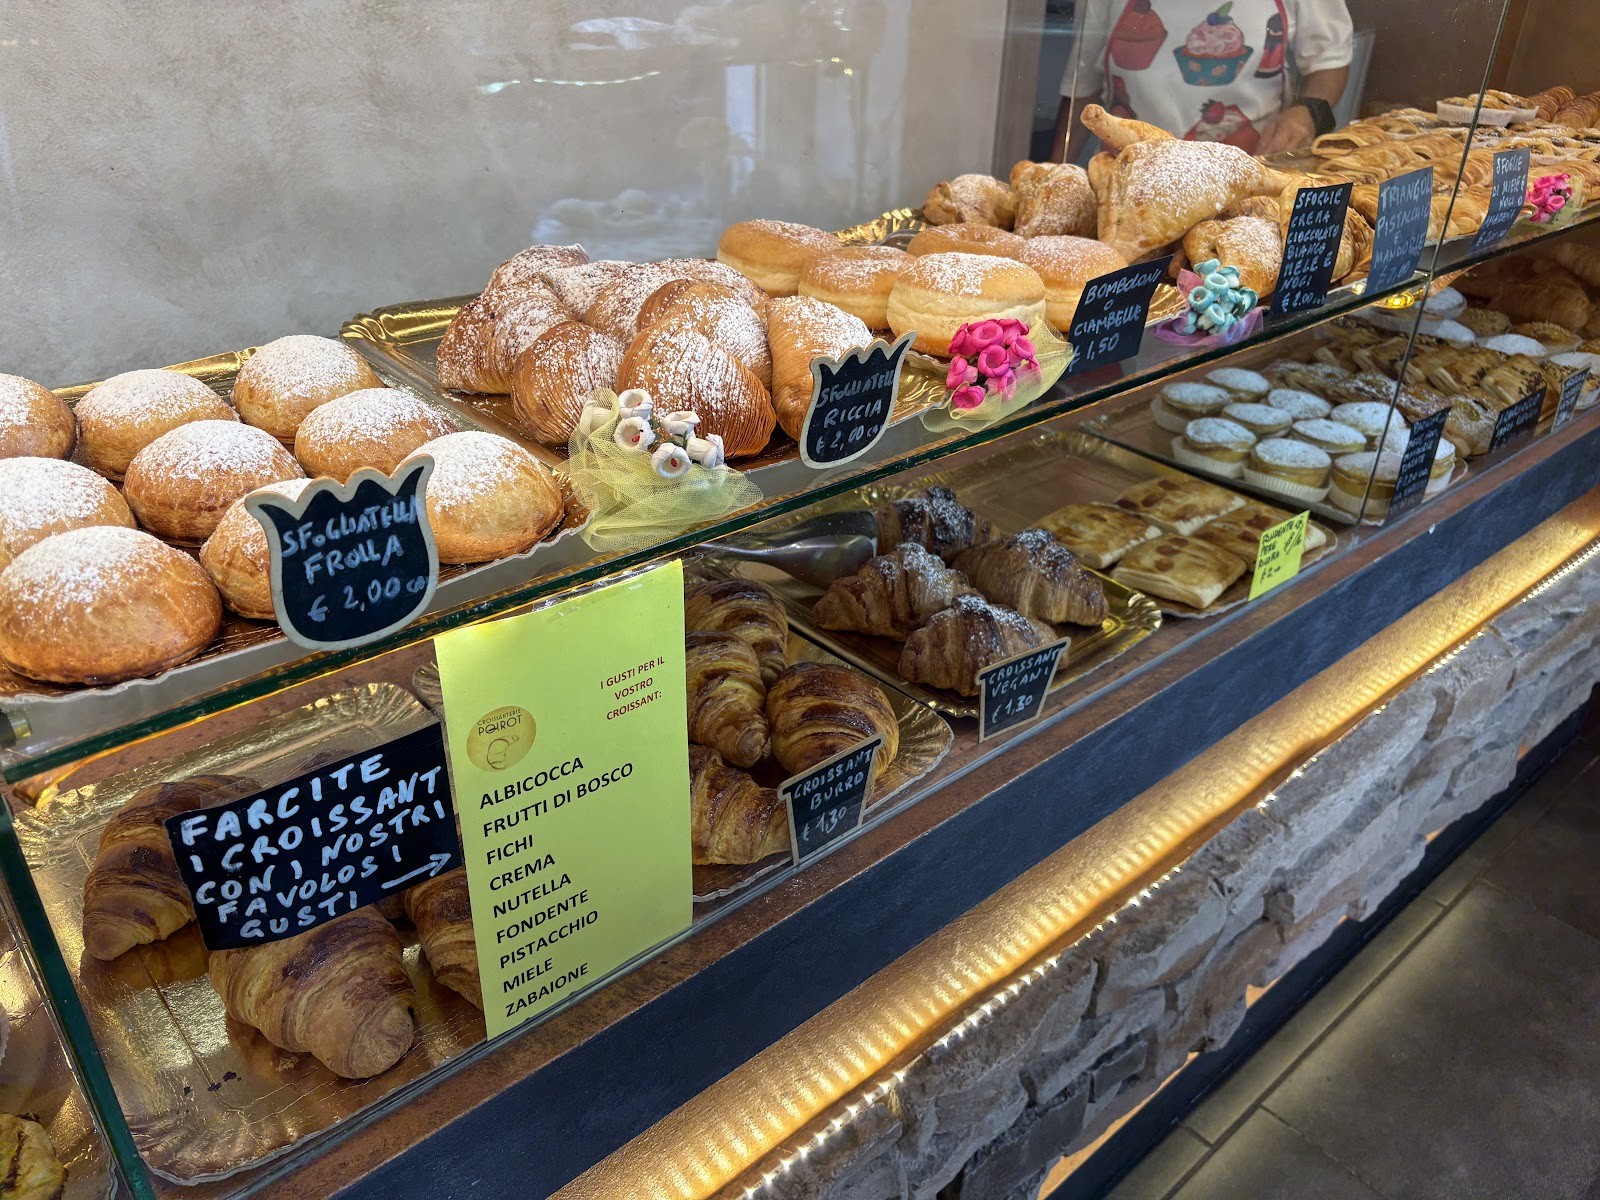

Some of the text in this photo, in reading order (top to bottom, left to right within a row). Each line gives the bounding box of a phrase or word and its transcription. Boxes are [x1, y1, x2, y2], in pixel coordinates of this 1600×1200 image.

[1295, 187, 1343, 210] SFOGLIE
[1290, 209, 1331, 229] CREMA
[1073, 303, 1142, 337] CIAMBELLE
[1086, 332, 1120, 361] 1,50
[823, 399, 883, 429] RICCIA
[829, 425, 865, 451] 2,00
[302, 534, 405, 586] FROLLA
[306, 594, 329, 623] €
[342, 576, 401, 612] 2,00
[606, 668, 636, 688] GUSTI
[637, 661, 656, 675] PER
[656, 655, 666, 667] IL
[988, 647, 1061, 685] CROISSANT
[991, 666, 1049, 698] VEGANI
[605, 690, 663, 721] CROISSANT:
[613, 677, 654, 701] VOSTRO
[477, 708, 522, 727] CROISSANTERIE
[477, 714, 523, 737] POIROT
[479, 756, 585, 810] ALBICOCCA
[793, 748, 873, 800] CROISSANT
[810, 771, 865, 811] BURRO
[179, 753, 391, 846] FARCITE
[483, 762, 634, 838] FRUTTI DI BOSCO
[189, 766, 442, 873] I CROISSANT
[814, 806, 847, 834] 1,30
[195, 864, 276, 905] CON
[321, 800, 446, 867] NOSTRI
[486, 834, 535, 866] FICHI
[488, 853, 556, 892] CREMA
[239, 890, 358, 938] GUSTI
[492, 873, 572, 919] NUTELLA
[496, 889, 589, 944] FONDENTE
[499, 910, 599, 970] PISTACCHIO
[503, 957, 554, 994] MIELE
[505, 962, 590, 1018] ZABAIONE
